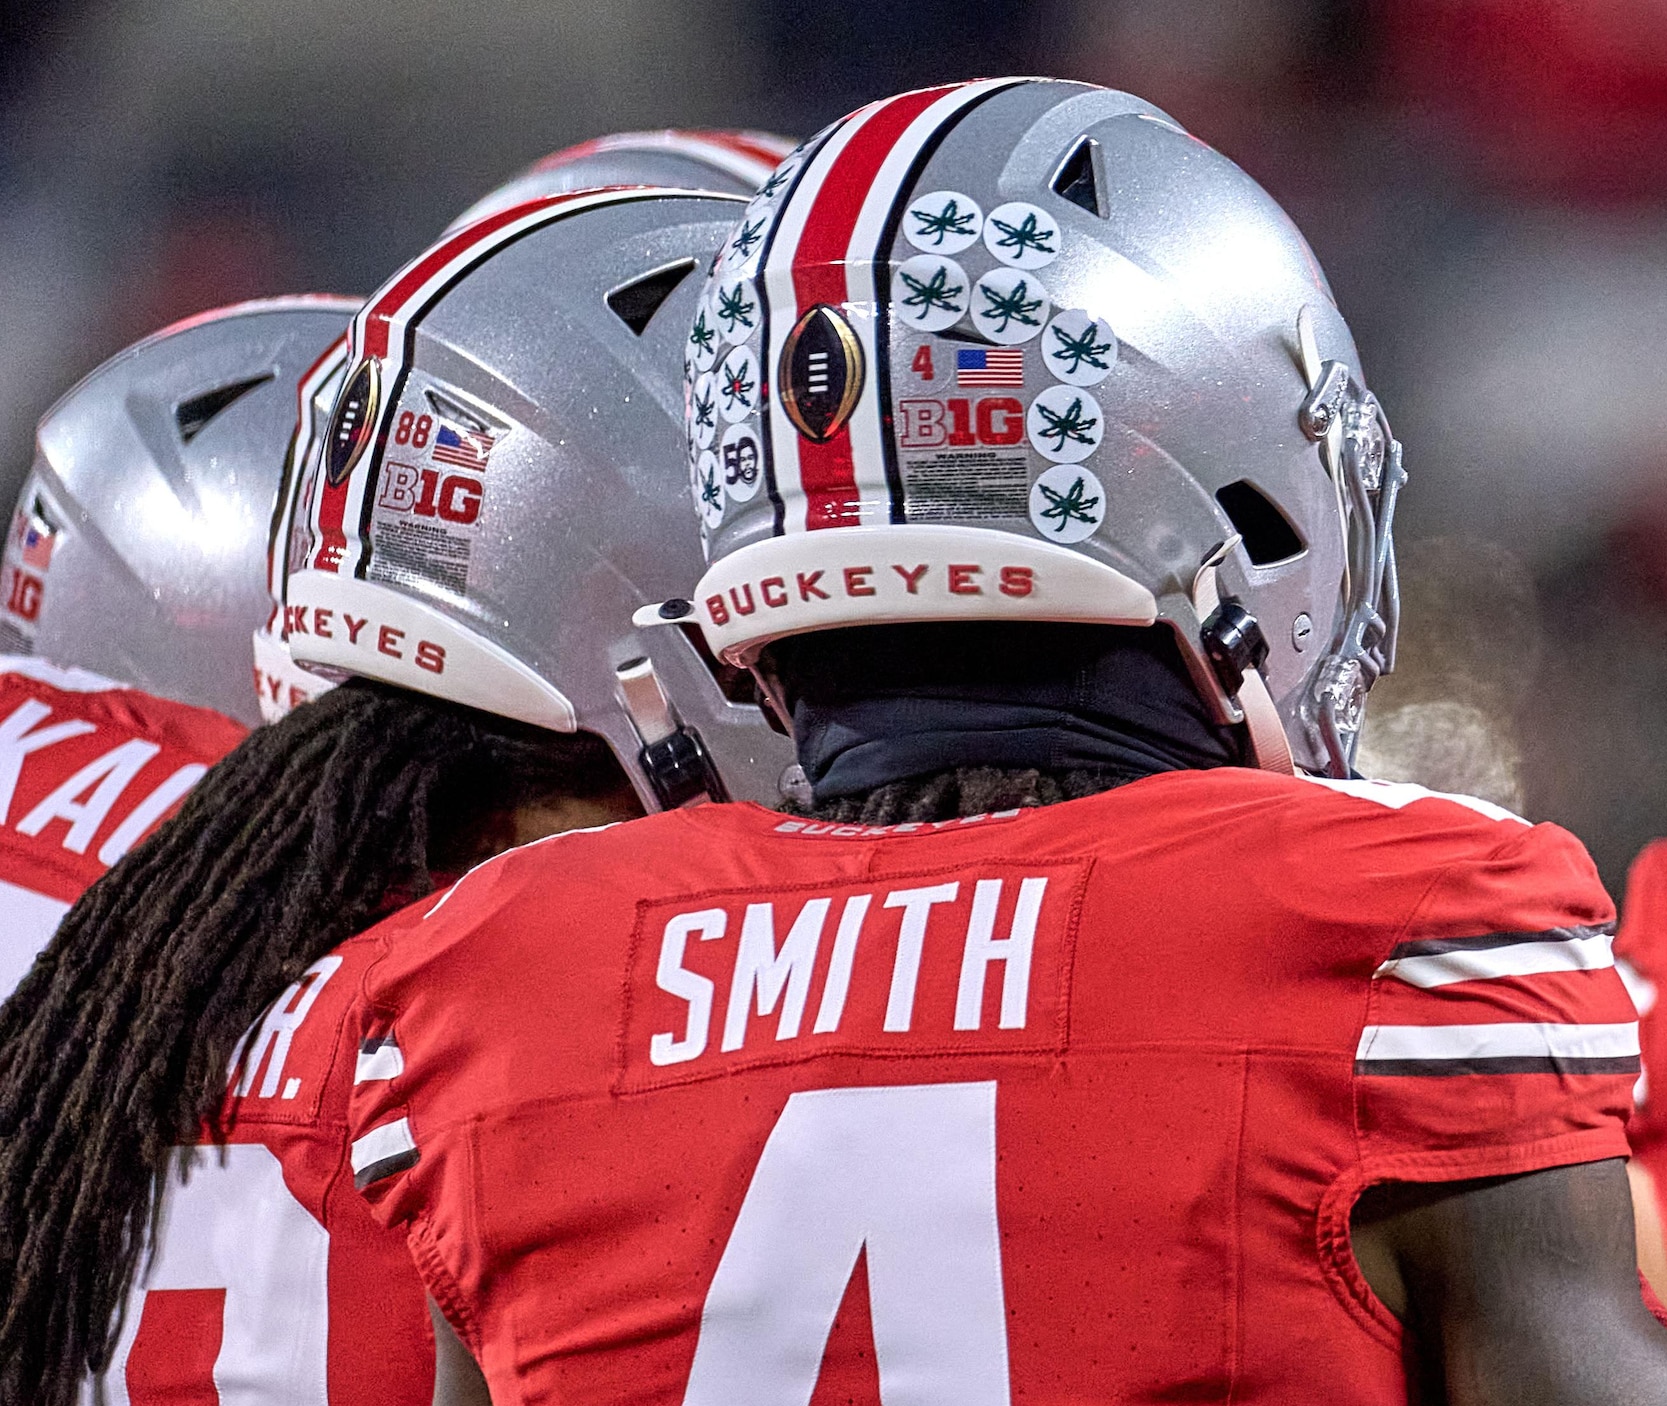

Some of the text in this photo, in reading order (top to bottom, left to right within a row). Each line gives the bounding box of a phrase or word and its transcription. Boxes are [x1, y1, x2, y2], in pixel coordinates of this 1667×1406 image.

[395, 410, 433, 449] 88
[705, 563, 1034, 625] BUCKEYES
[648, 876, 1049, 1067] SMITH
